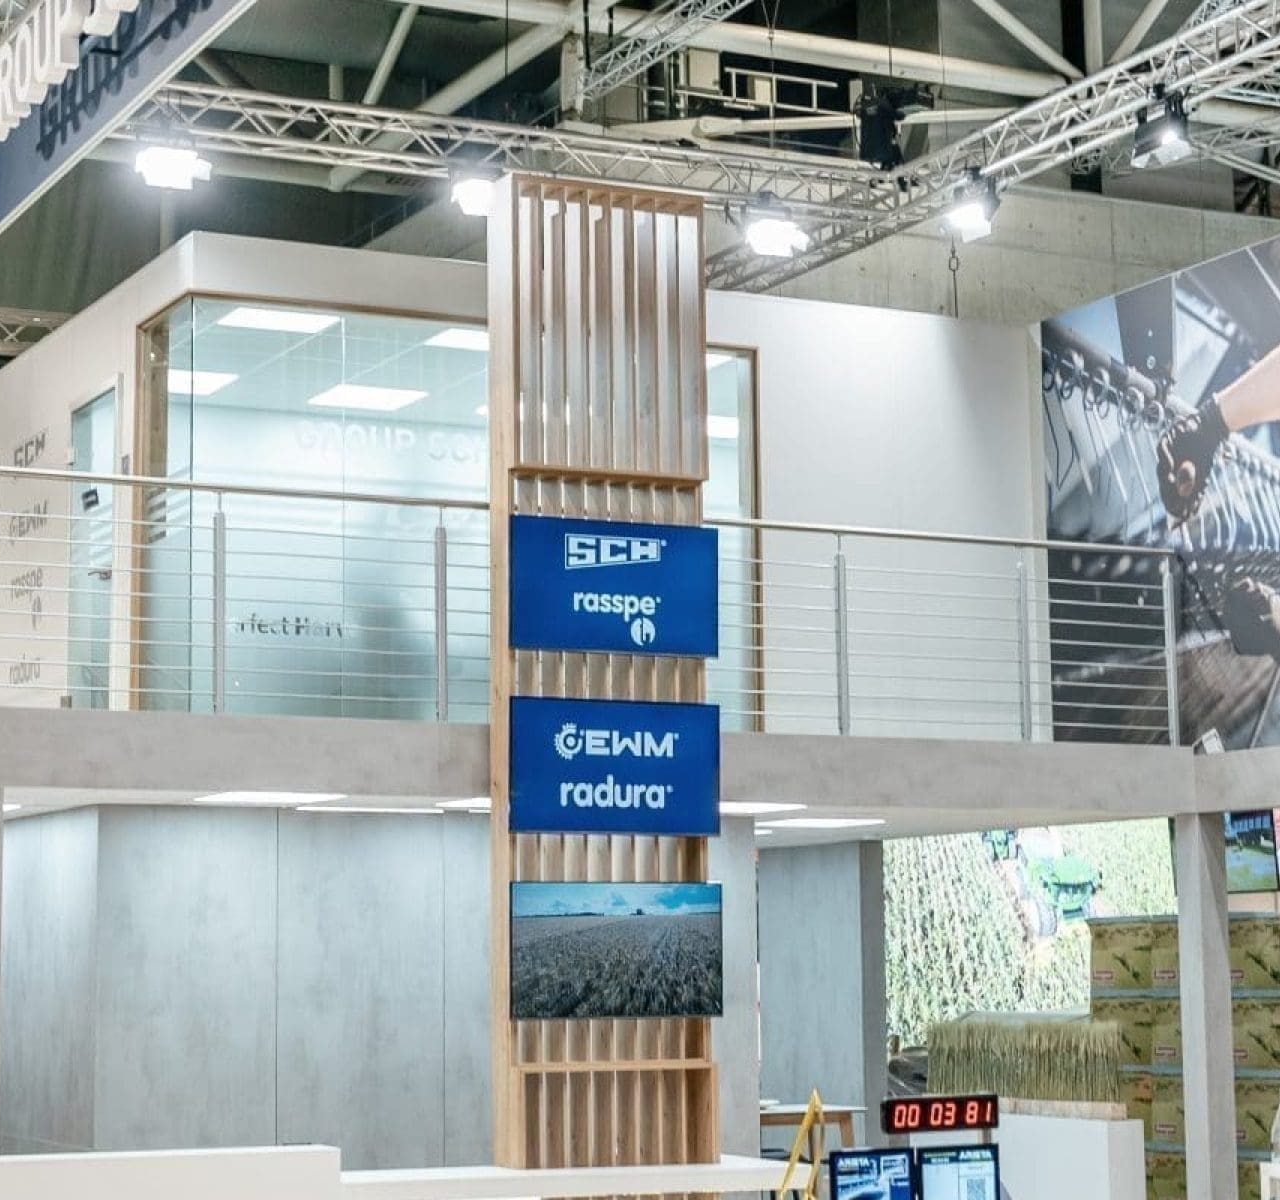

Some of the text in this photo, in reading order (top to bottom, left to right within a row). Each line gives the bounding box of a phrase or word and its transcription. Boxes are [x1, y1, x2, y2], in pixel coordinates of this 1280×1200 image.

[567, 535, 659, 567] SCH
[573, 591, 656, 622] rasspe
[560, 774, 665, 809] radura
[894, 1101, 991, 1128] 00 03 81
